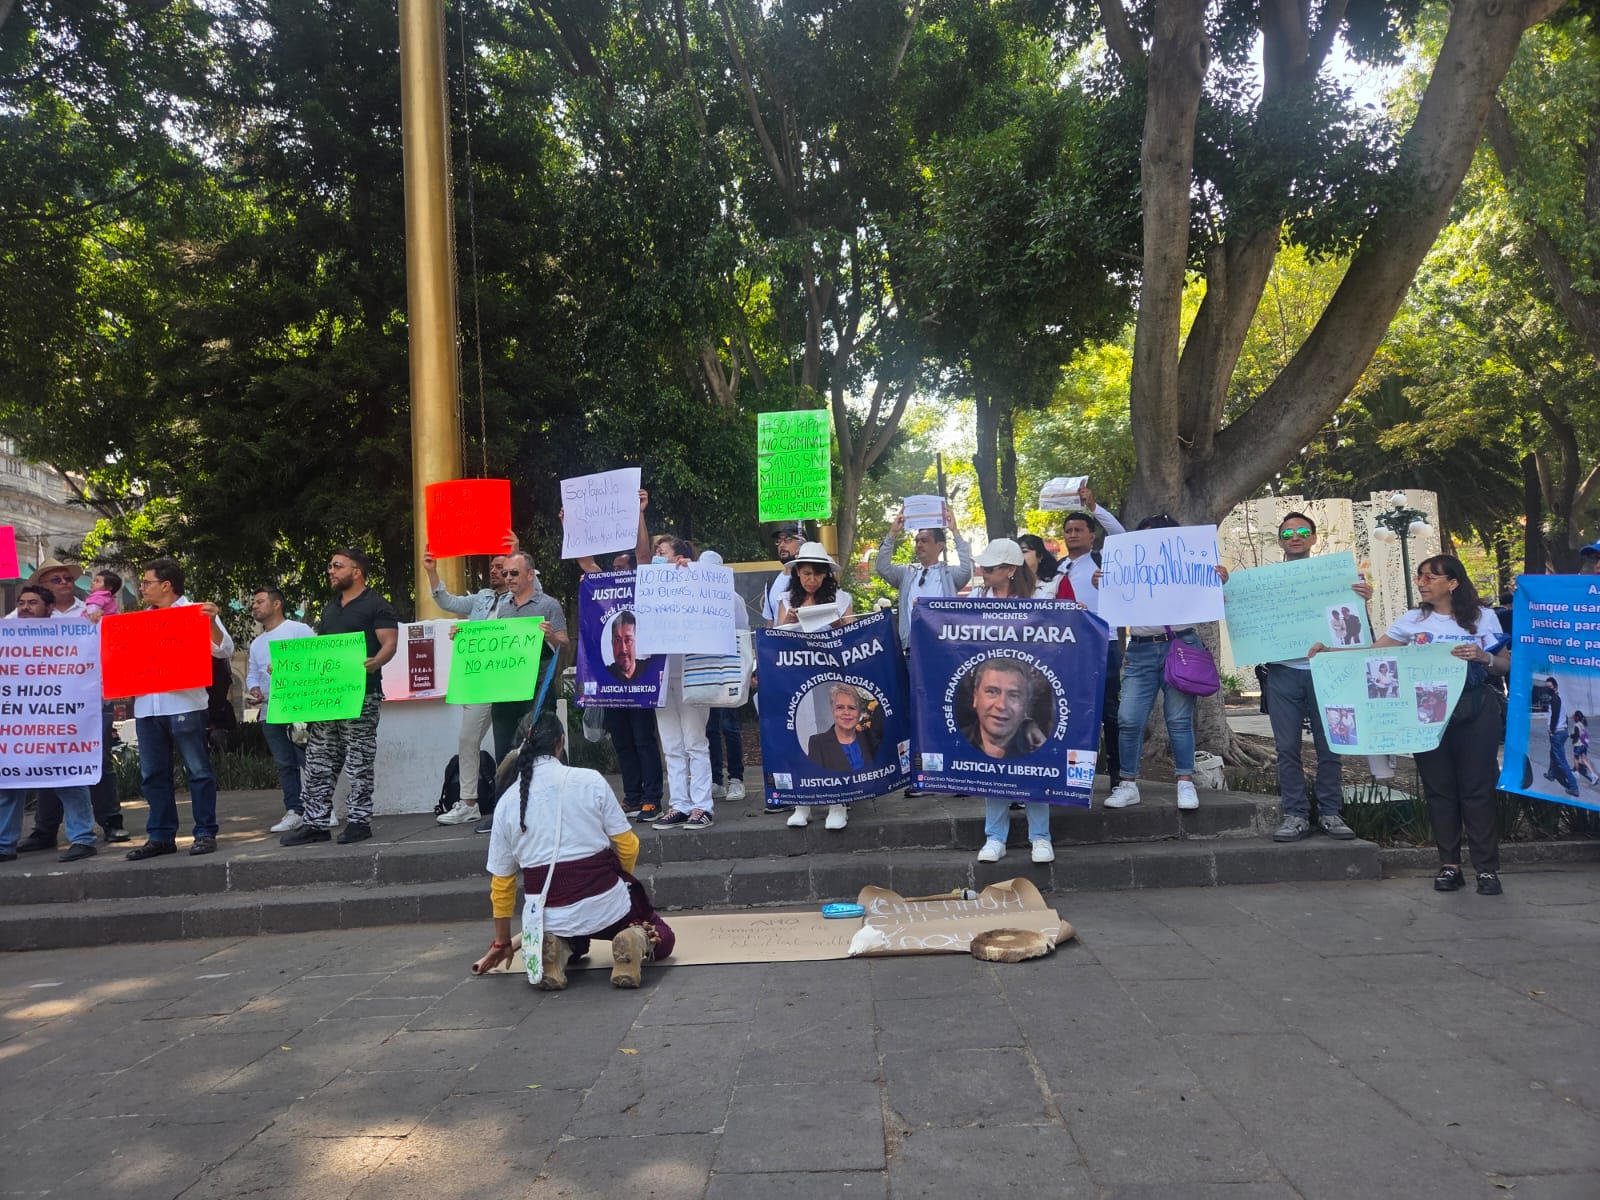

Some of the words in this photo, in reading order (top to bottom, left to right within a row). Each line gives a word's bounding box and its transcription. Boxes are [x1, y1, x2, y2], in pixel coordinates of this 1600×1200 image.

[591, 586, 633, 601] JUSTICIA
[929, 601, 973, 610] COLECTIVO
[974, 601, 1018, 610] NACIONAL
[1019, 602, 1033, 610] NO
[1034, 600, 1053, 610] MÁS
[1529, 601, 1569, 613] Aunque
[982, 612, 1028, 620] INOCENTES
[1531, 618, 1571, 629] justicia
[2, 627, 16, 637] no
[18, 624, 58, 637] criminal
[61, 624, 98, 636] PUEBLA
[831, 628, 844, 638] NO
[859, 612, 885, 628] PRESOS
[938, 624, 1018, 642] JUSTICIA
[1022, 625, 1077, 643] PARA
[1520, 634, 1534, 643] mi
[1538, 636, 1562, 645] amor
[1566, 637, 1581, 647] de
[457, 634, 536, 654] CECOFAM
[776, 650, 840, 668] JUSTICIA
[841, 638, 885, 666] PARA
[987, 648, 1035, 664] HECTOR
[1548, 654, 1566, 664] que
[277, 659, 301, 672] Mis
[465, 660, 482, 672] NO
[485, 656, 527, 671] AYUDA
[945, 652, 986, 703] FRANCISCO
[1034, 659, 1066, 697] LARIOS
[17, 684, 62, 697] HIJOS
[600, 685, 623, 693] JUSTICIA
[628, 685, 657, 693] LIBERTAD
[786, 691, 804, 731] BLANCA
[800, 671, 844, 692] PATRICIA
[844, 675, 875, 691] ROJAS
[874, 686, 894, 718] TAGLE
[942, 704, 957, 734] JOSÉ
[1054, 698, 1071, 741] GÓMEZ
[0, 724, 78, 736] HOMBRES
[0, 767, 21, 777] OS
[799, 778, 841, 788] JUSTICIA
[842, 776, 851, 785] Y
[852, 764, 896, 784] LIBERTAD
[951, 760, 997, 774] JUSTICIA
[997, 764, 1006, 774] Y
[1007, 765, 1060, 778] LIBERTAD
